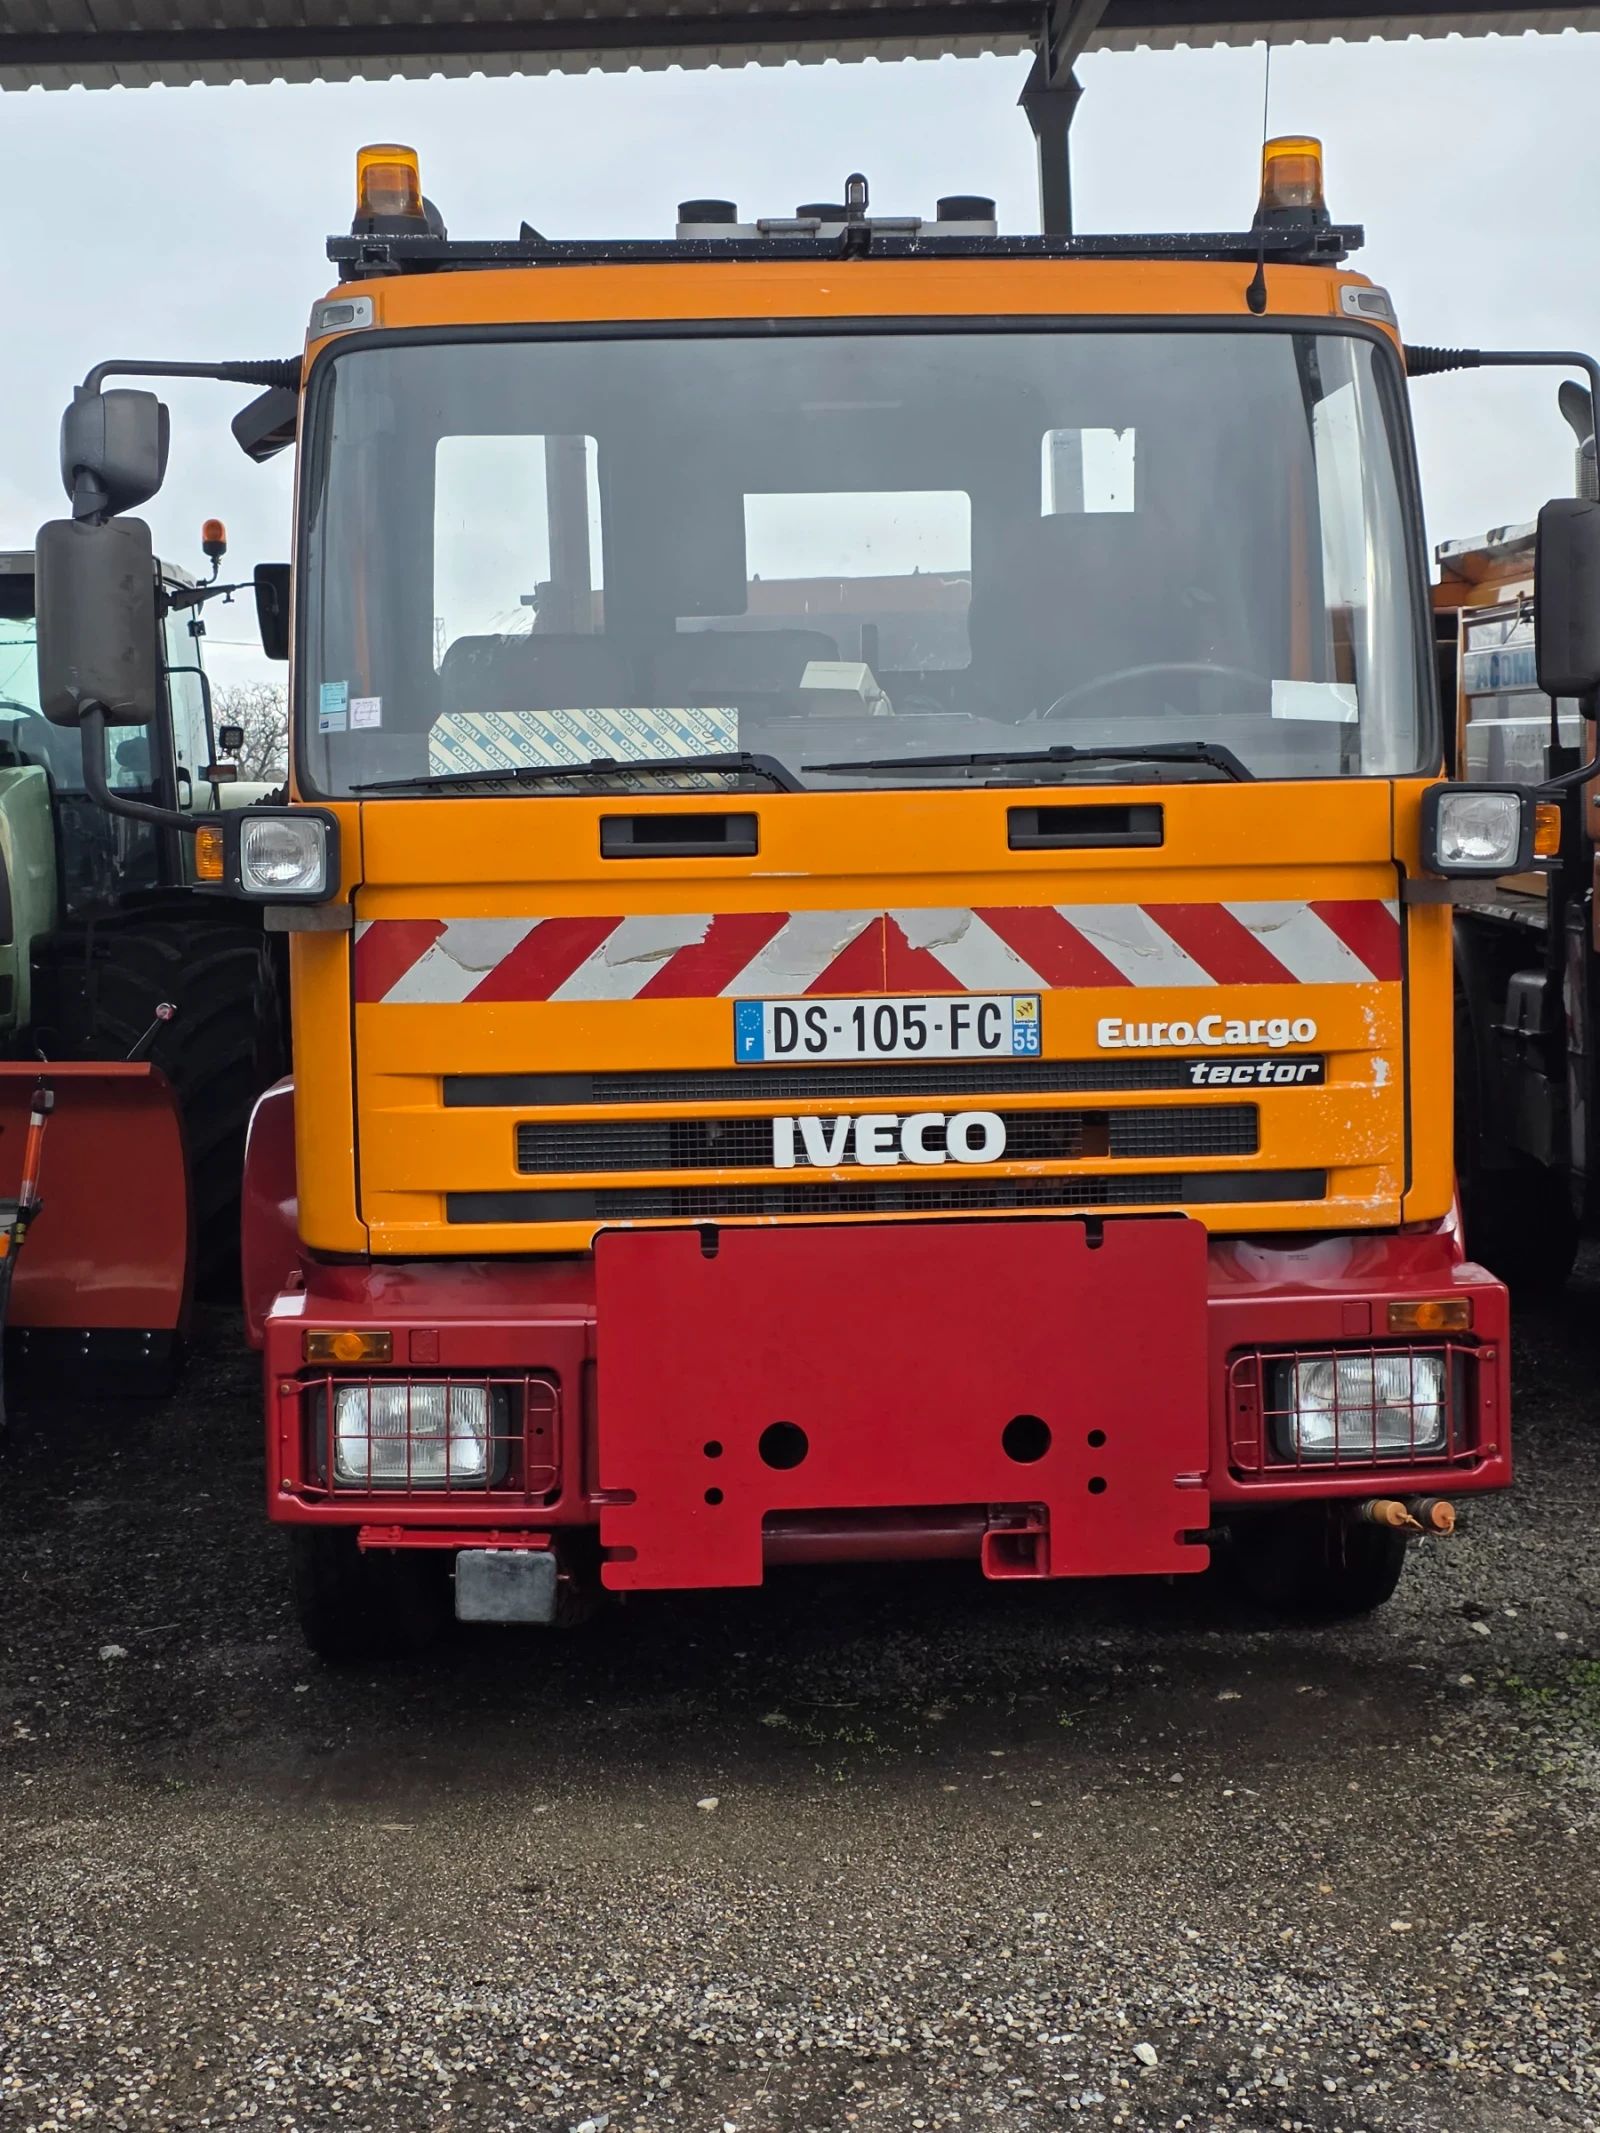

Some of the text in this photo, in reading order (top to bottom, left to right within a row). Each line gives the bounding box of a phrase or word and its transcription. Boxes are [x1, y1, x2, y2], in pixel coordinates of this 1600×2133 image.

[451, 713, 481, 741] IVECO
[485, 712, 547, 766] VECO IVECO
[518, 711, 579, 765] VECO IVECO
[552, 709, 606, 759] ECO IVECO
[586, 708, 645, 760] ECO IVECO
[619, 708, 678, 758] ECO IVECO
[653, 708, 707, 756] ECO IVECO
[745, 1037, 755, 1051] F
[773, 1002, 1002, 1053] DS-105-FC
[1013, 1028, 1038, 1051] 55
[1097, 1015, 1317, 1048] EuroCargo
[1189, 1061, 1320, 1084] tector
[772, 1111, 1007, 1168] IVECO
